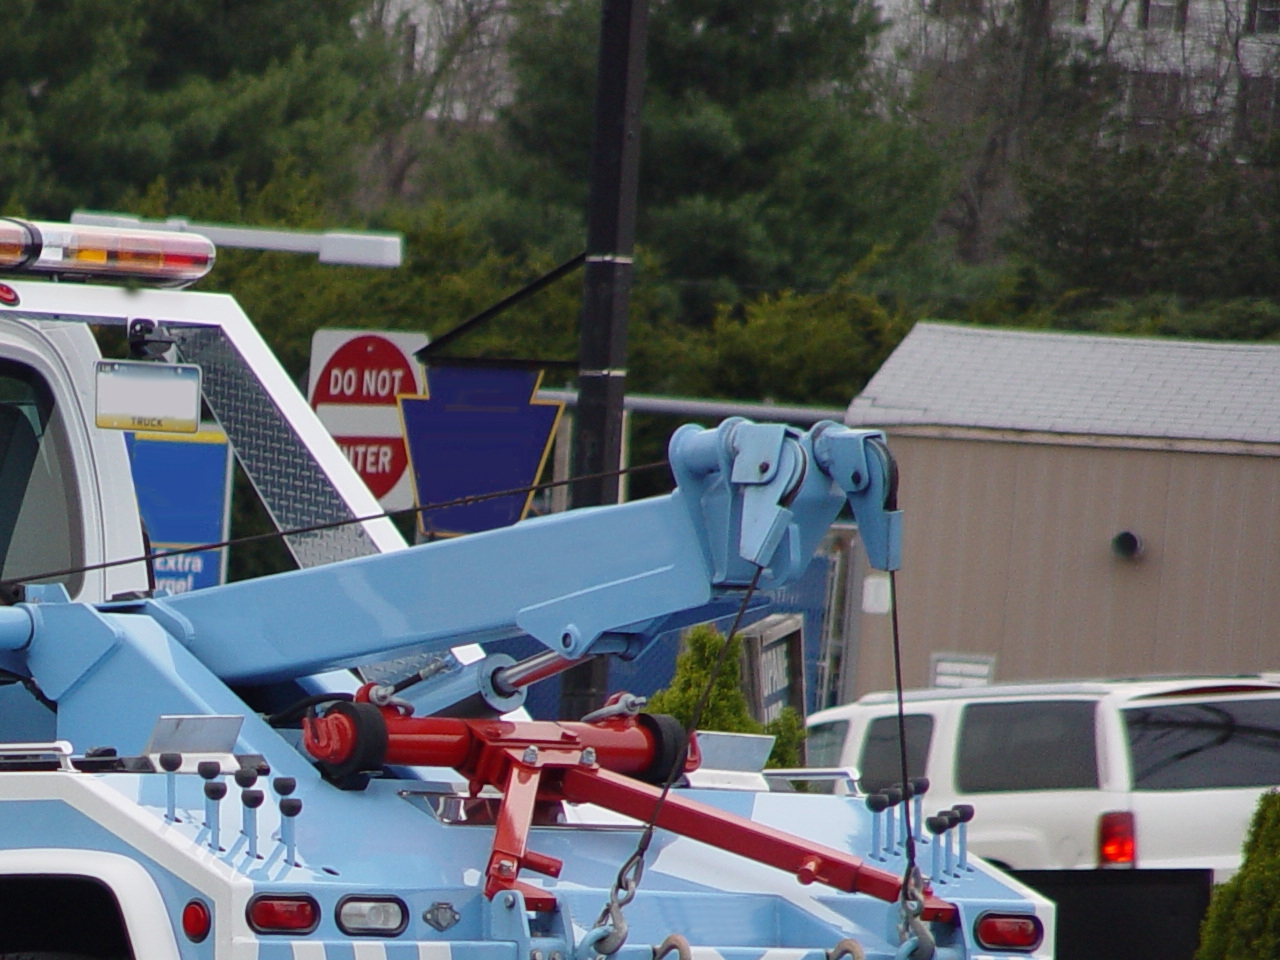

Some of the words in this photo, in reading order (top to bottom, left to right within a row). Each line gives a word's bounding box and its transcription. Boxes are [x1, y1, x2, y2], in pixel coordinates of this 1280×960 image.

[329, 368, 357, 396] DO
[362, 369, 404, 397] NOT
[131, 416, 163, 427] TRUCK
[154, 550, 203, 573] Extra
